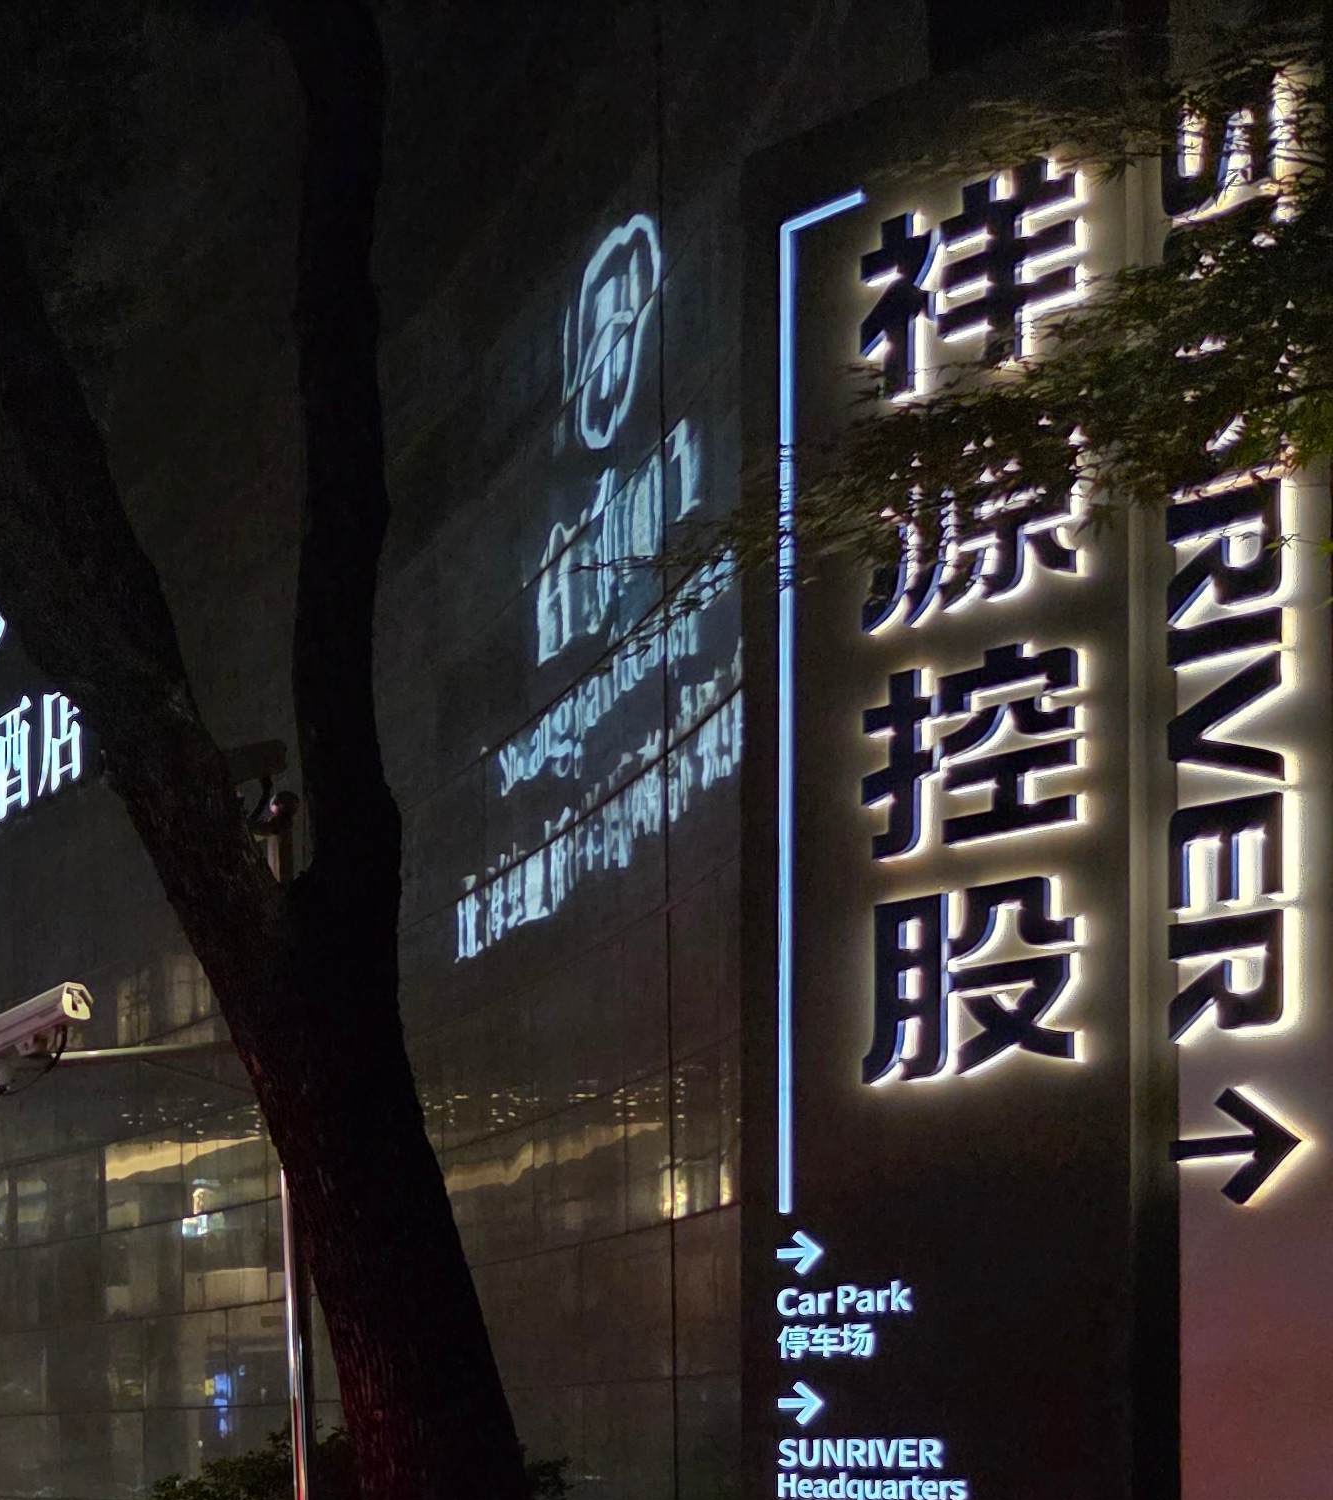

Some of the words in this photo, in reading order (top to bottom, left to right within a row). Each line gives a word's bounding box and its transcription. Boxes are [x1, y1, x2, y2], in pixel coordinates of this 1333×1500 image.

[1161, 76, 1293, 1044] SRIVER
[776, 1287, 833, 1317] Car
[836, 1280, 913, 1314] Park
[776, 1322, 876, 1359] 停车场
[777, 1438, 944, 1469] SUNRIVER
